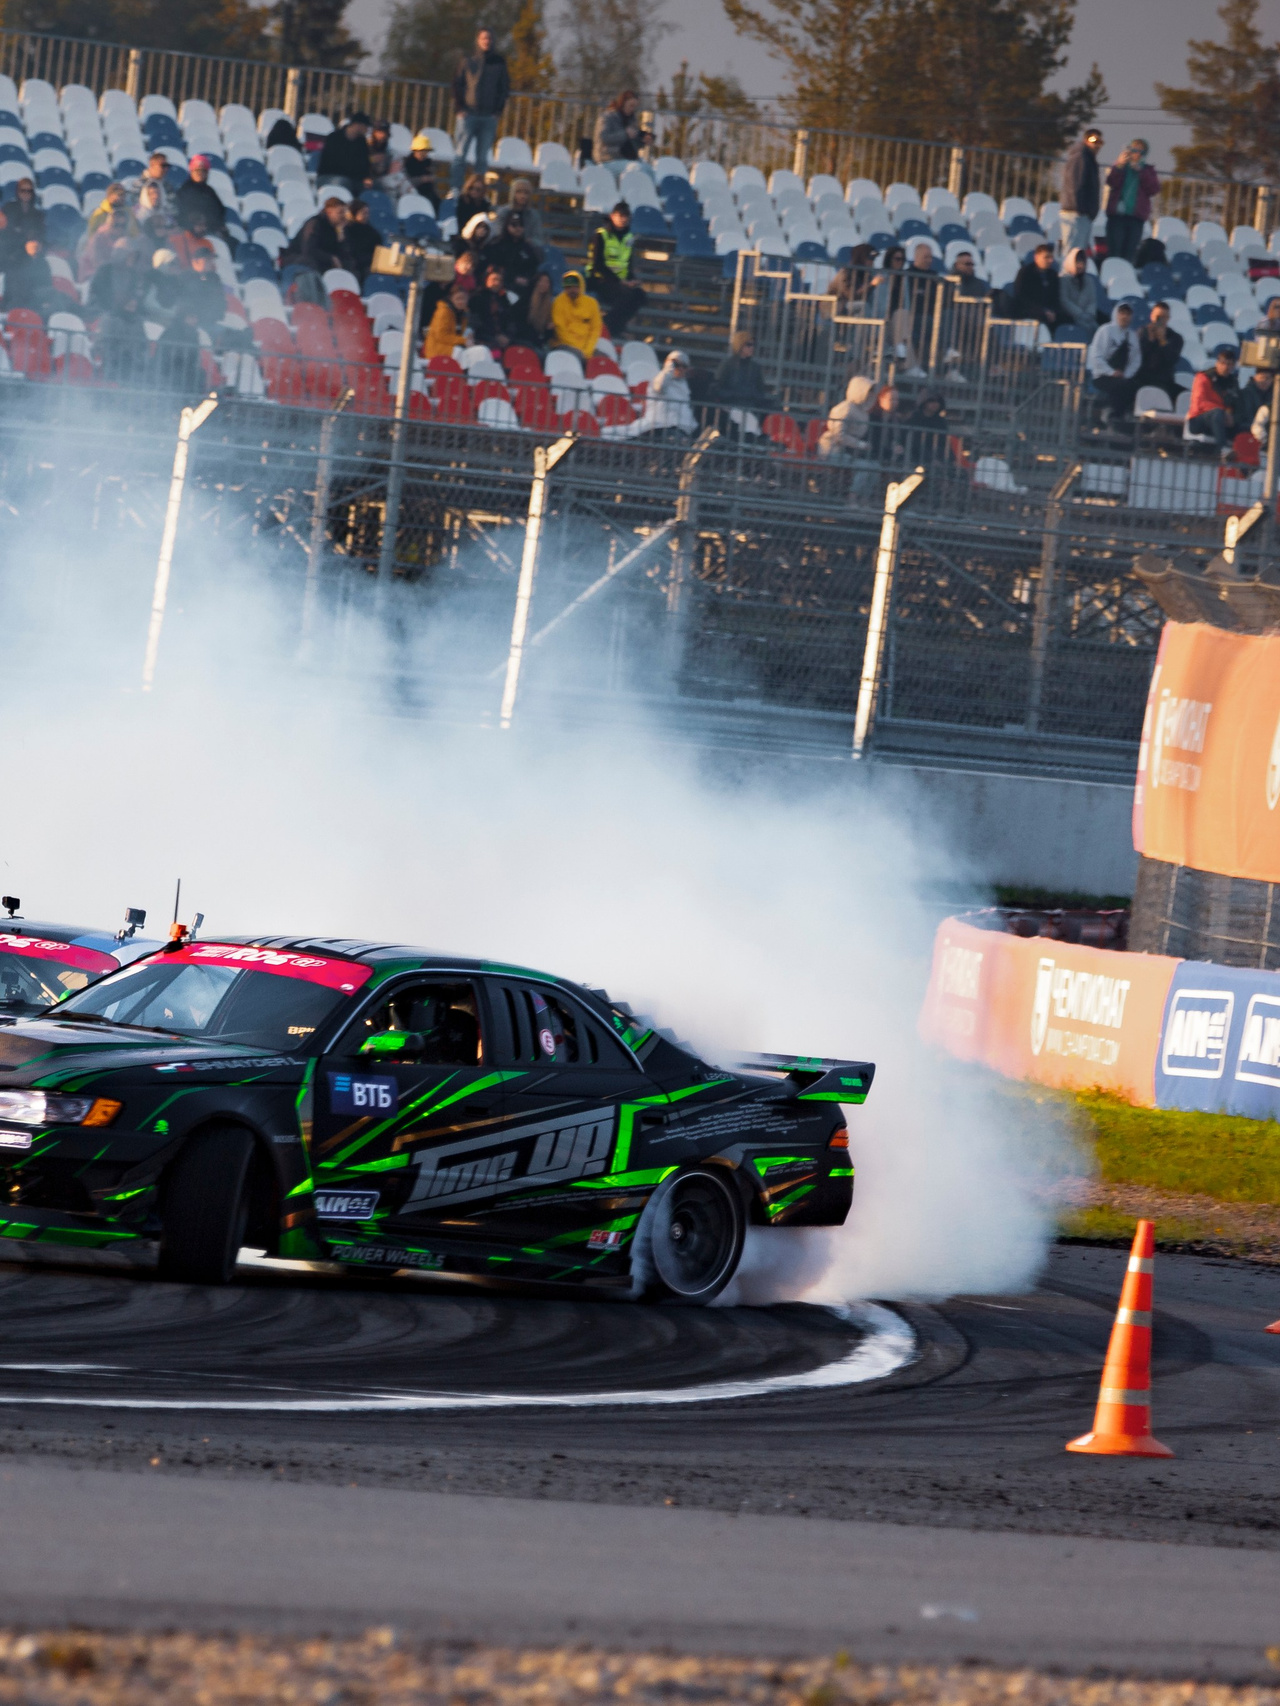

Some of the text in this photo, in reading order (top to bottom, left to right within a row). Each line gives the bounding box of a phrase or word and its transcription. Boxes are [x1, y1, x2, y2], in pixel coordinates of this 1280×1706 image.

[35, 940, 70, 951] GP
[224, 948, 300, 966] RDS
[290, 957, 327, 968] GP
[352, 1082, 392, 1108] ВТБ
[330, 1245, 447, 1267] POWER WHEELS
